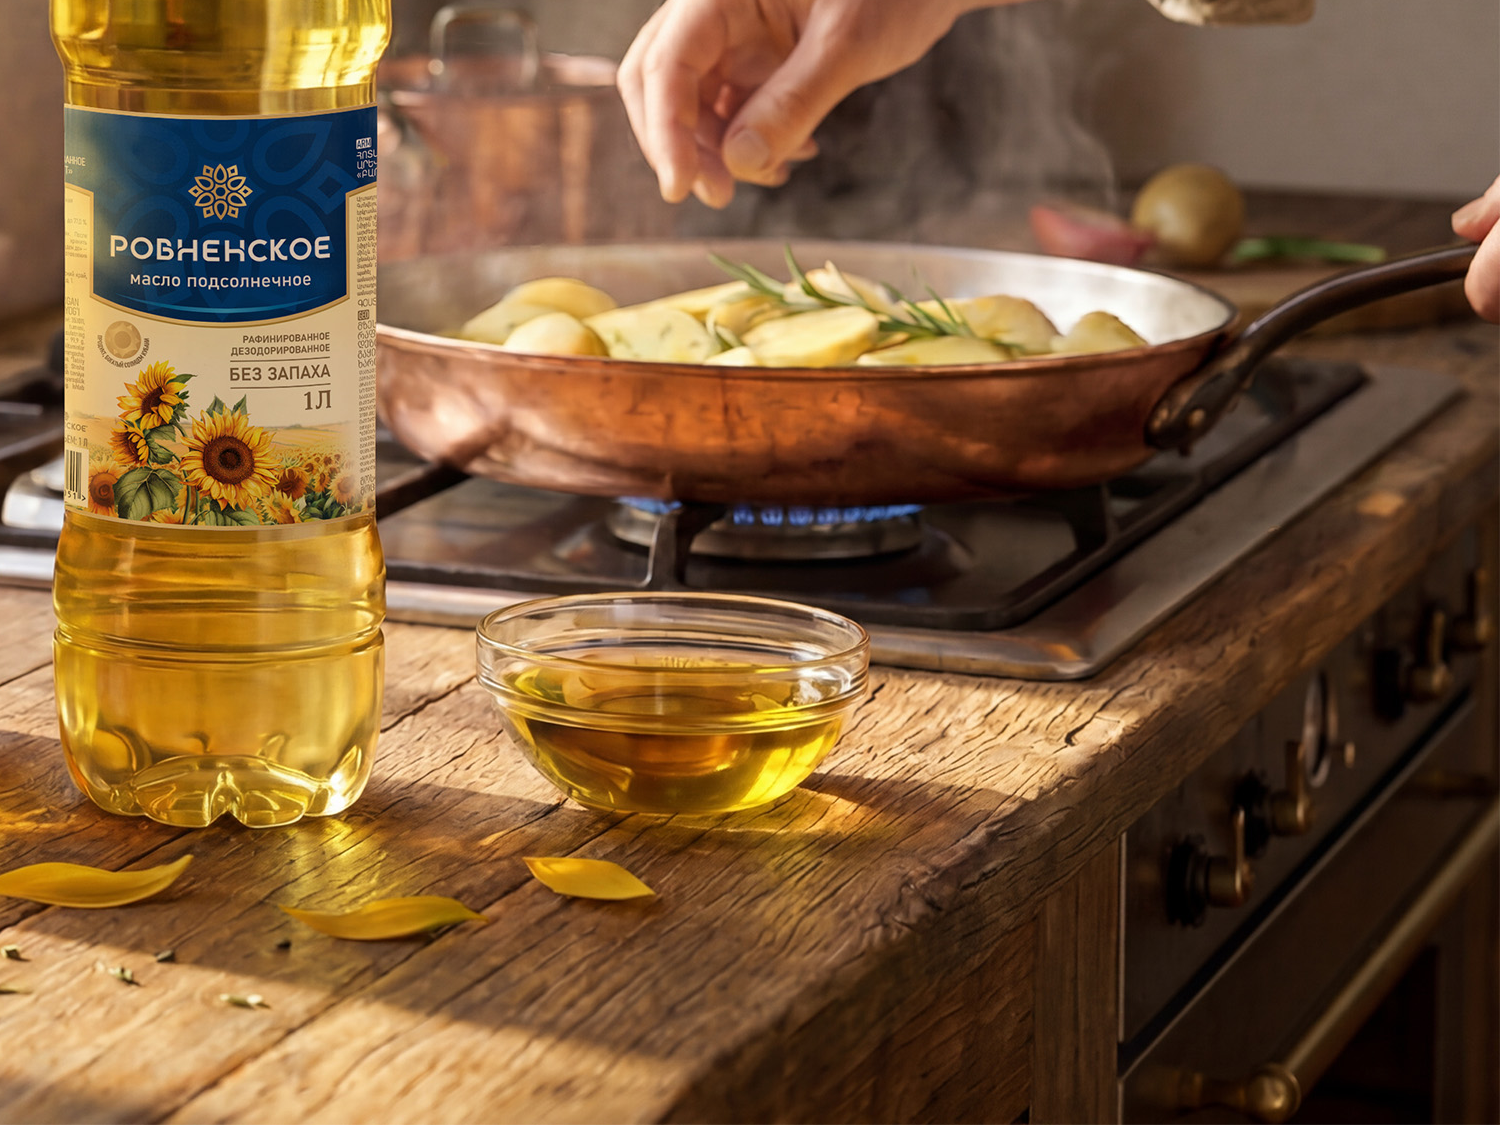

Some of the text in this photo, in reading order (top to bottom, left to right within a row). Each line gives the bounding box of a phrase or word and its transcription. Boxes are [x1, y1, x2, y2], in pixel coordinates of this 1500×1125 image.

[110, 234, 331, 262] РОВНЕНСКОЕ
[130, 274, 311, 290] масло подсолнечное
[243, 332, 330, 343] РАФИНИРОВАННОЕ
[231, 343, 330, 356] ДЕЗОДОРИРОВАННОЕ
[230, 364, 331, 381] БЕЗ ЗАПАХА
[304, 390, 332, 411] 1Л
